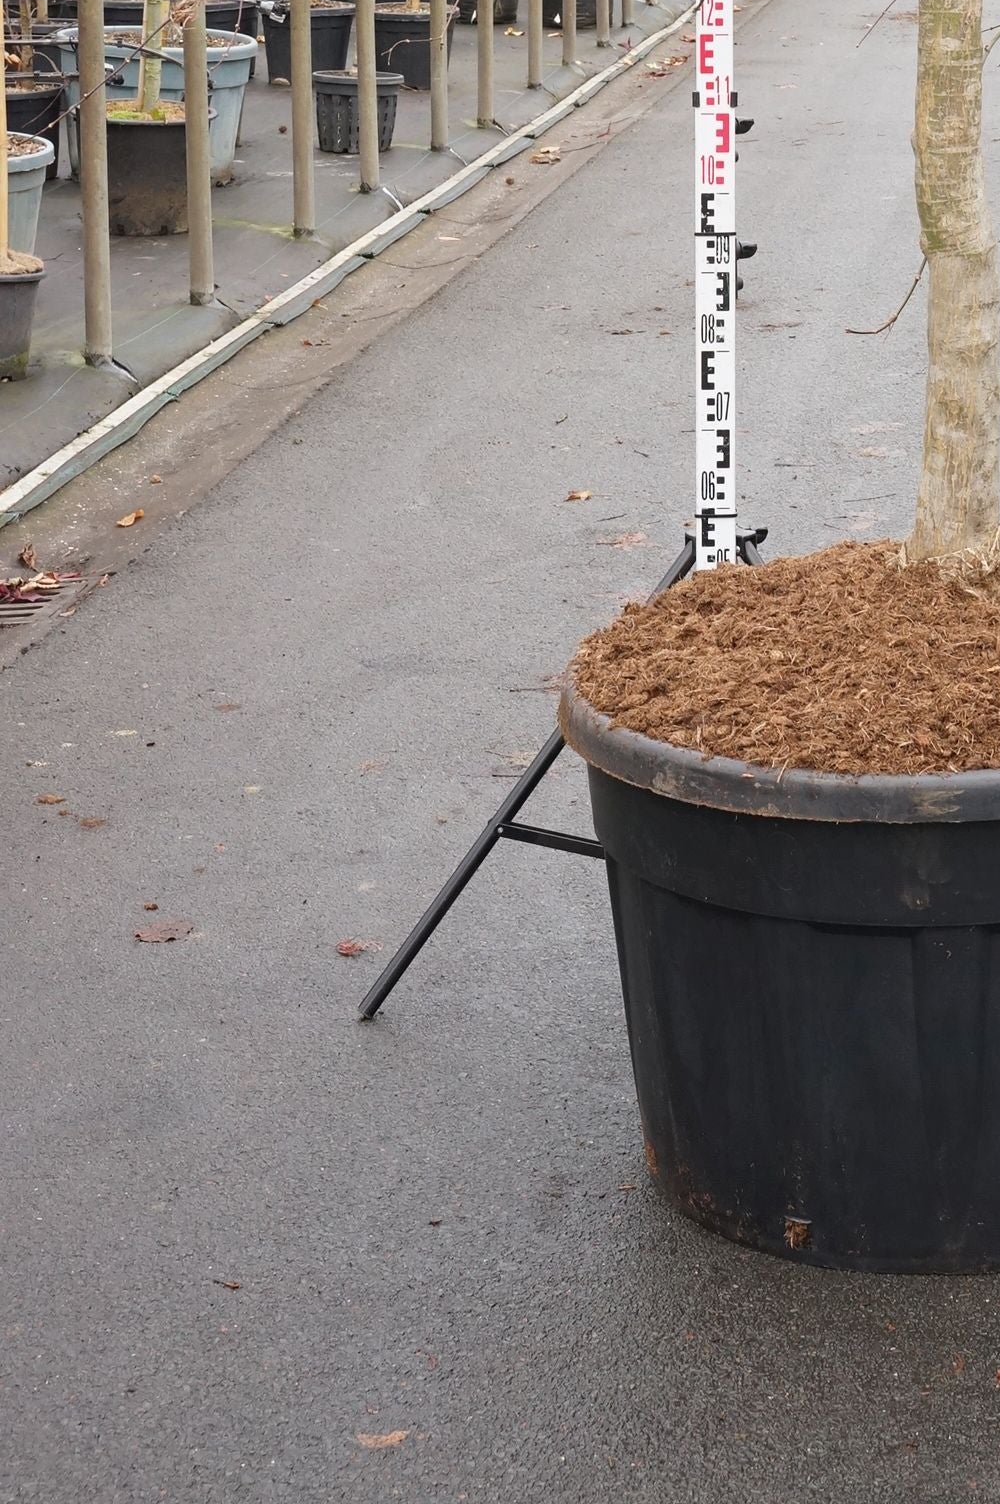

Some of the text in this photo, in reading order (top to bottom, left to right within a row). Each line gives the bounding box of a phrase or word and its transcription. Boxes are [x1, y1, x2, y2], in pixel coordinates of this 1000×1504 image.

[715, 76, 730, 106] 11
[700, 155, 715, 185] 10
[716, 235, 730, 264] 09
[701, 314, 715, 344] 08
[716, 392, 730, 421] 07
[701, 471, 715, 501] 06
